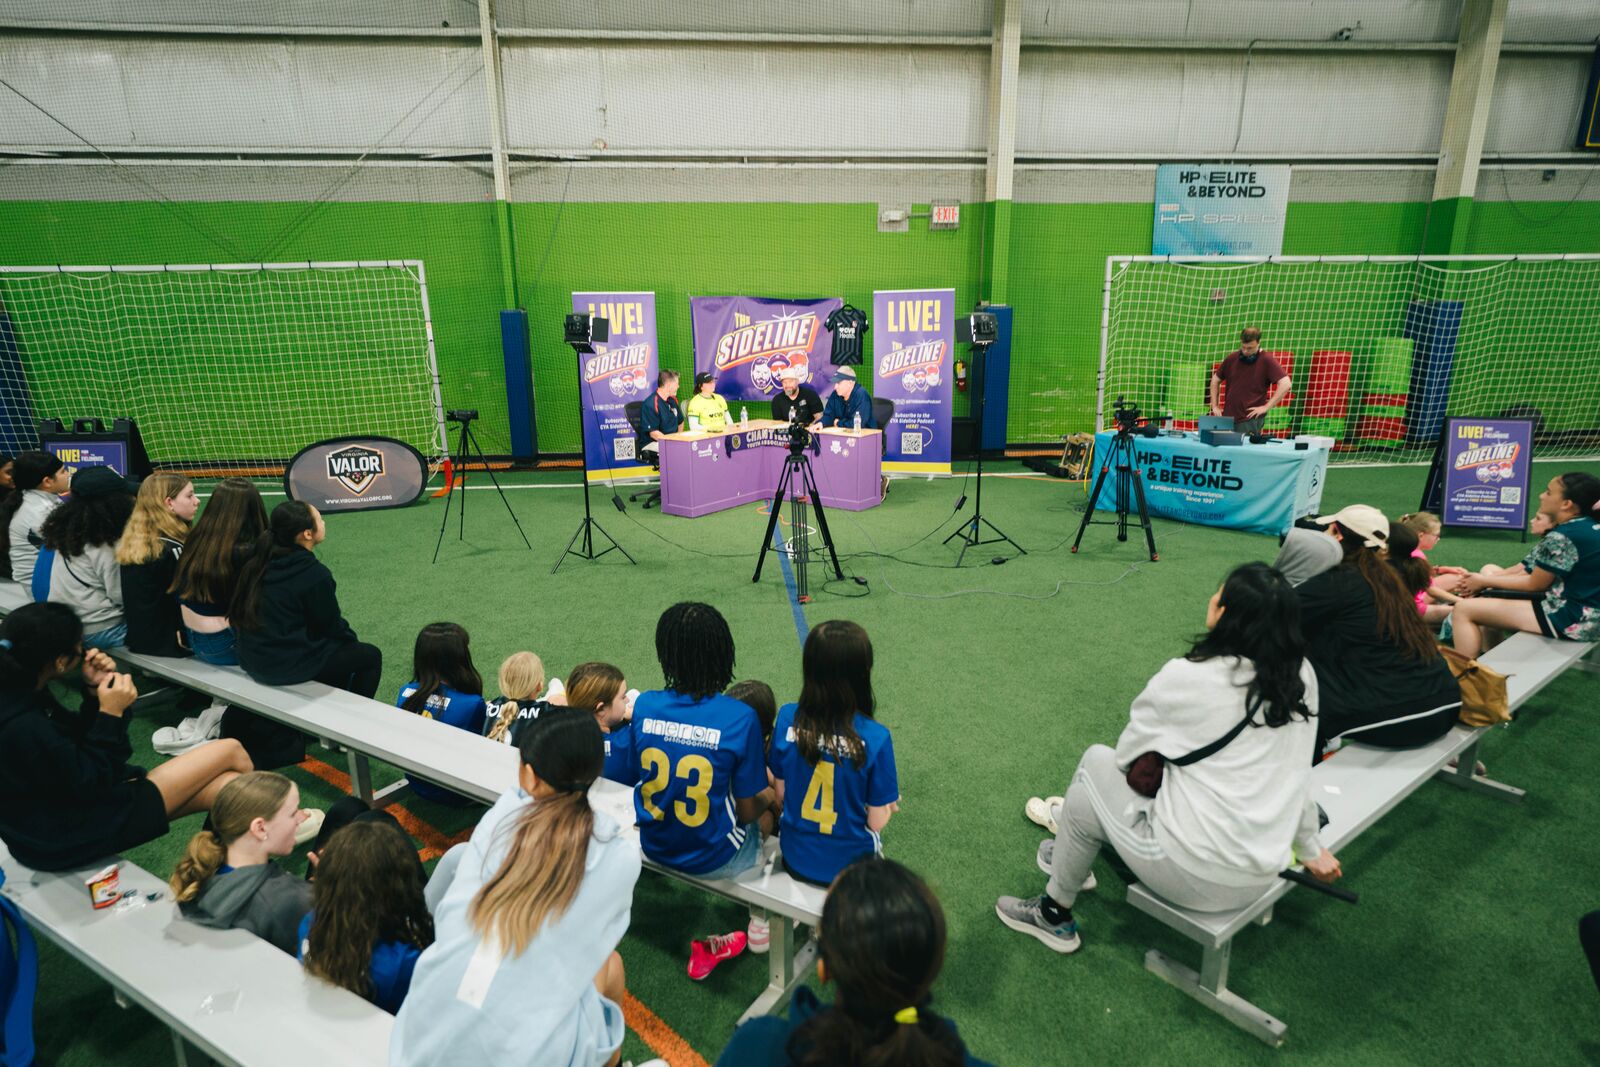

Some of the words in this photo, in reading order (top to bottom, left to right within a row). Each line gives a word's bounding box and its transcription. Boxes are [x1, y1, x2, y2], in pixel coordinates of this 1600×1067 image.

[1179, 171, 1201, 184] HP
[1209, 171, 1257, 184] ELITE
[887, 300, 941, 332] LIVE!
[717, 318, 812, 366] SIDELINE
[586, 345, 648, 380] SIDELINE
[881, 343, 942, 375] SIDELINE
[1458, 425, 1483, 439] LIVE!
[56, 448, 80, 462] LIVE!
[330, 456, 381, 475] VALOR
[1137, 451, 1162, 465] HP
[1171, 455, 1232, 474] ELITE
[1456, 444, 1515, 467] SIDELINE
[1186, 495, 1201, 503] Since
[642, 718, 721, 744] cheron
[663, 736, 719, 751] orthodontics
[641, 747, 714, 827] 23
[801, 760, 838, 835] 4
